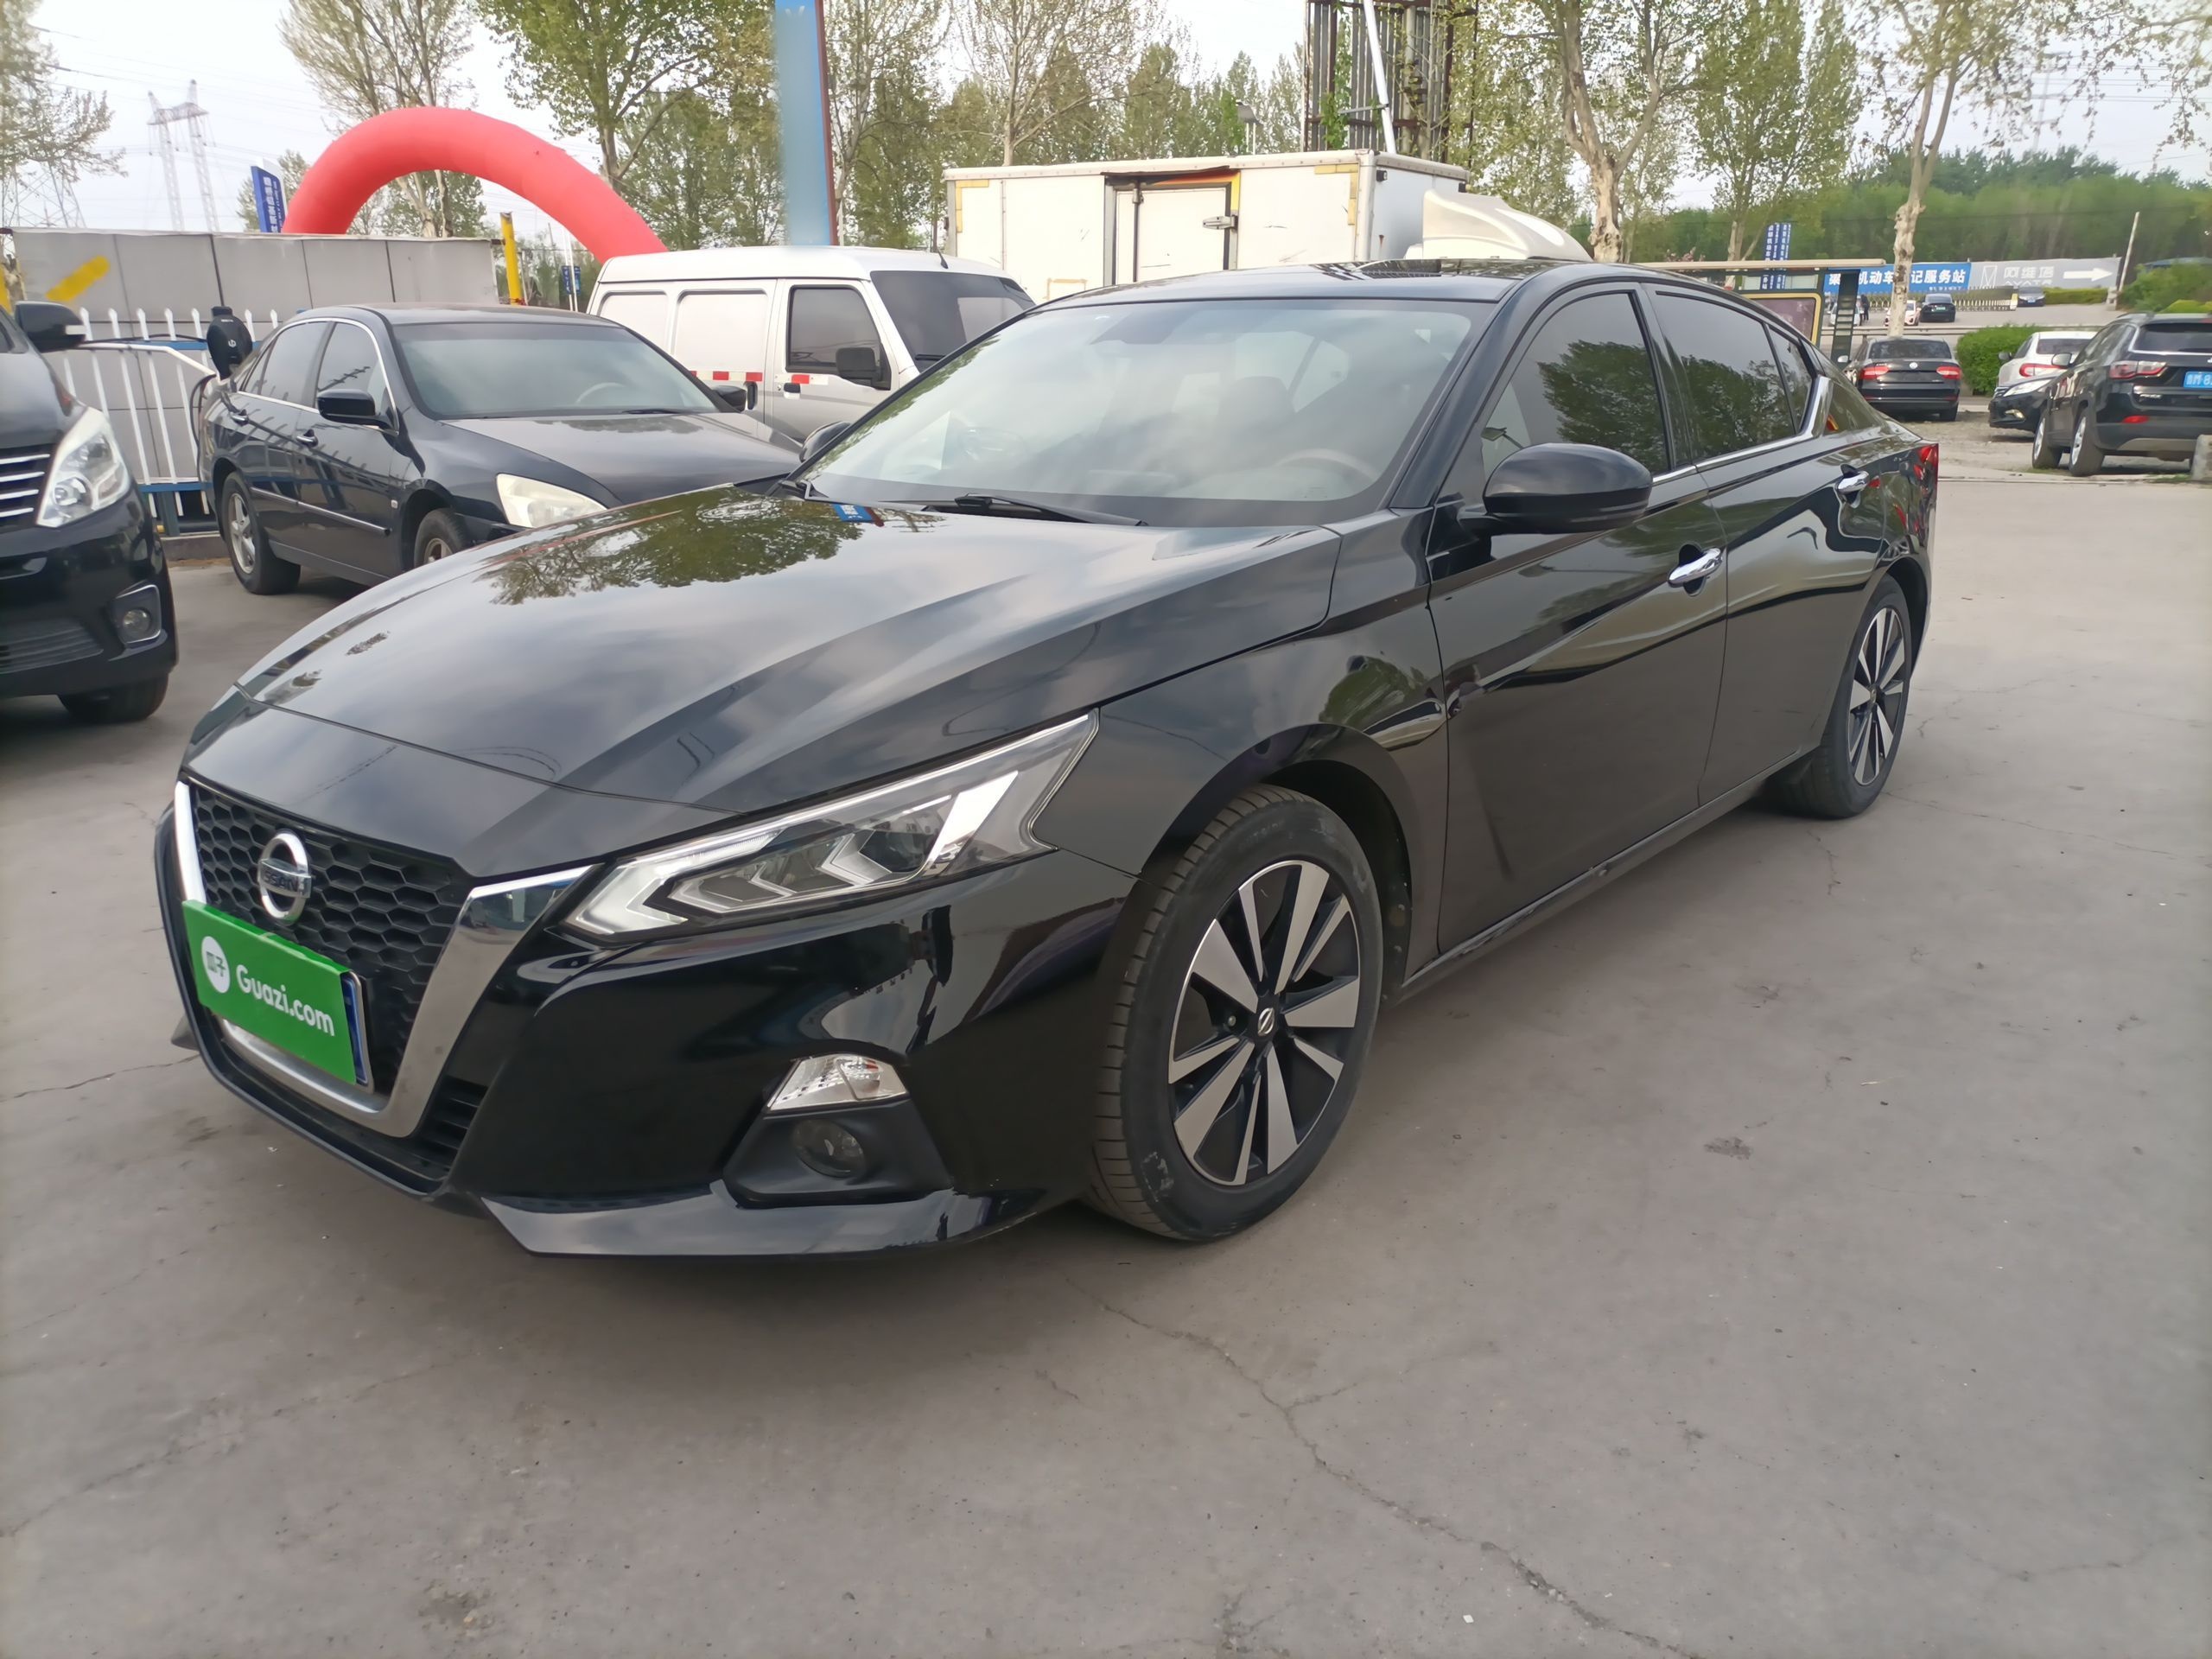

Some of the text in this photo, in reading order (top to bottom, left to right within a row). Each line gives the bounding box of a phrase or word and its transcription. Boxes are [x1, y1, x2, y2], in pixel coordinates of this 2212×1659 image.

[1829, 269, 1966, 285] 梁机动车记服务站
[236, 964, 335, 1037] Guazi.com
